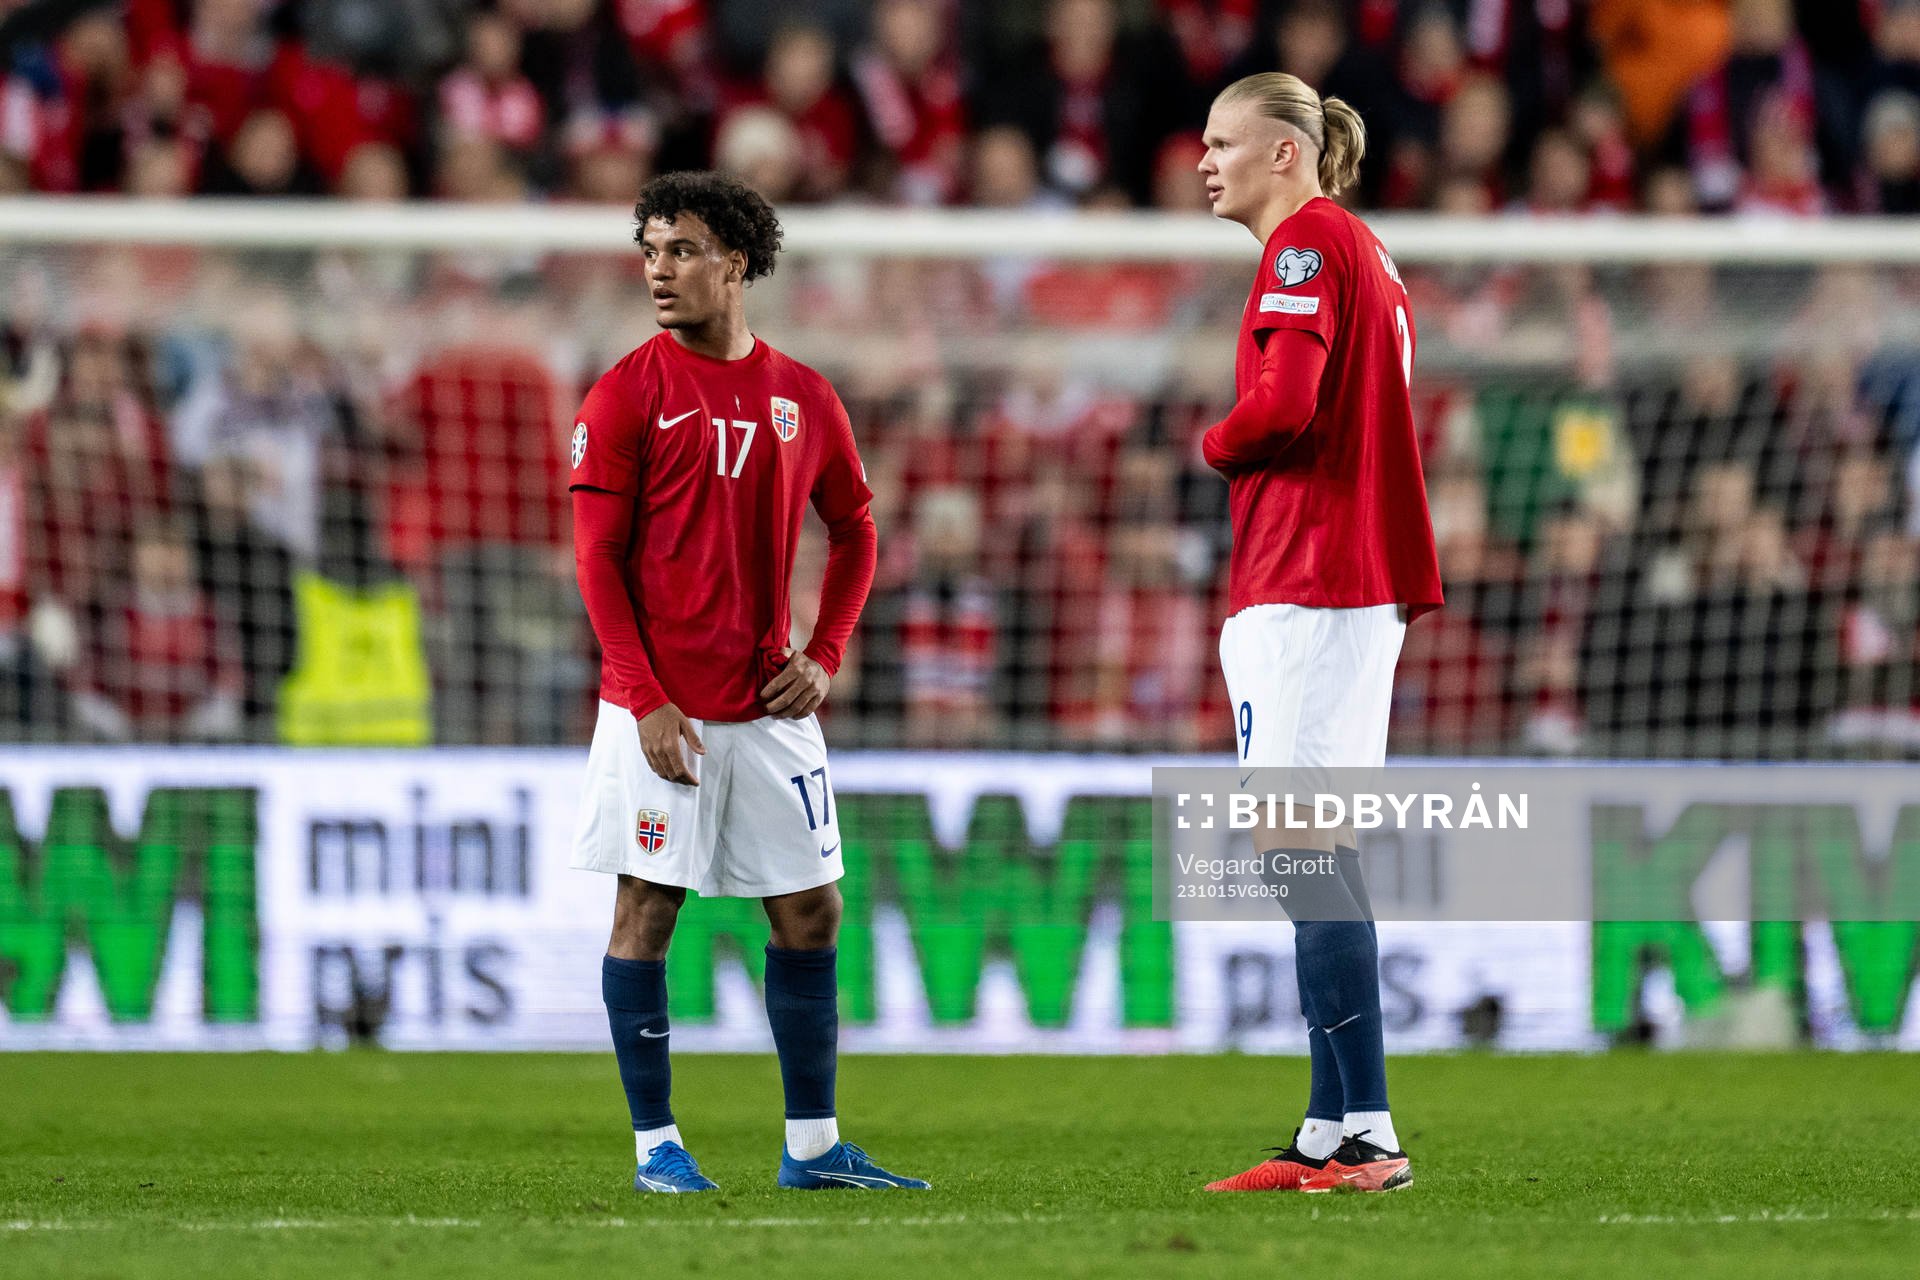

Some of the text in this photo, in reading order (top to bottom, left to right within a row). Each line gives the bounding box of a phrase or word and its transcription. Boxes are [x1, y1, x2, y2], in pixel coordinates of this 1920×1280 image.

[711, 418, 758, 479] 17
[1240, 701, 1252, 760] 9
[790, 766, 830, 831] 17
[308, 785, 532, 895] mini
[313, 914, 513, 1042] pris
